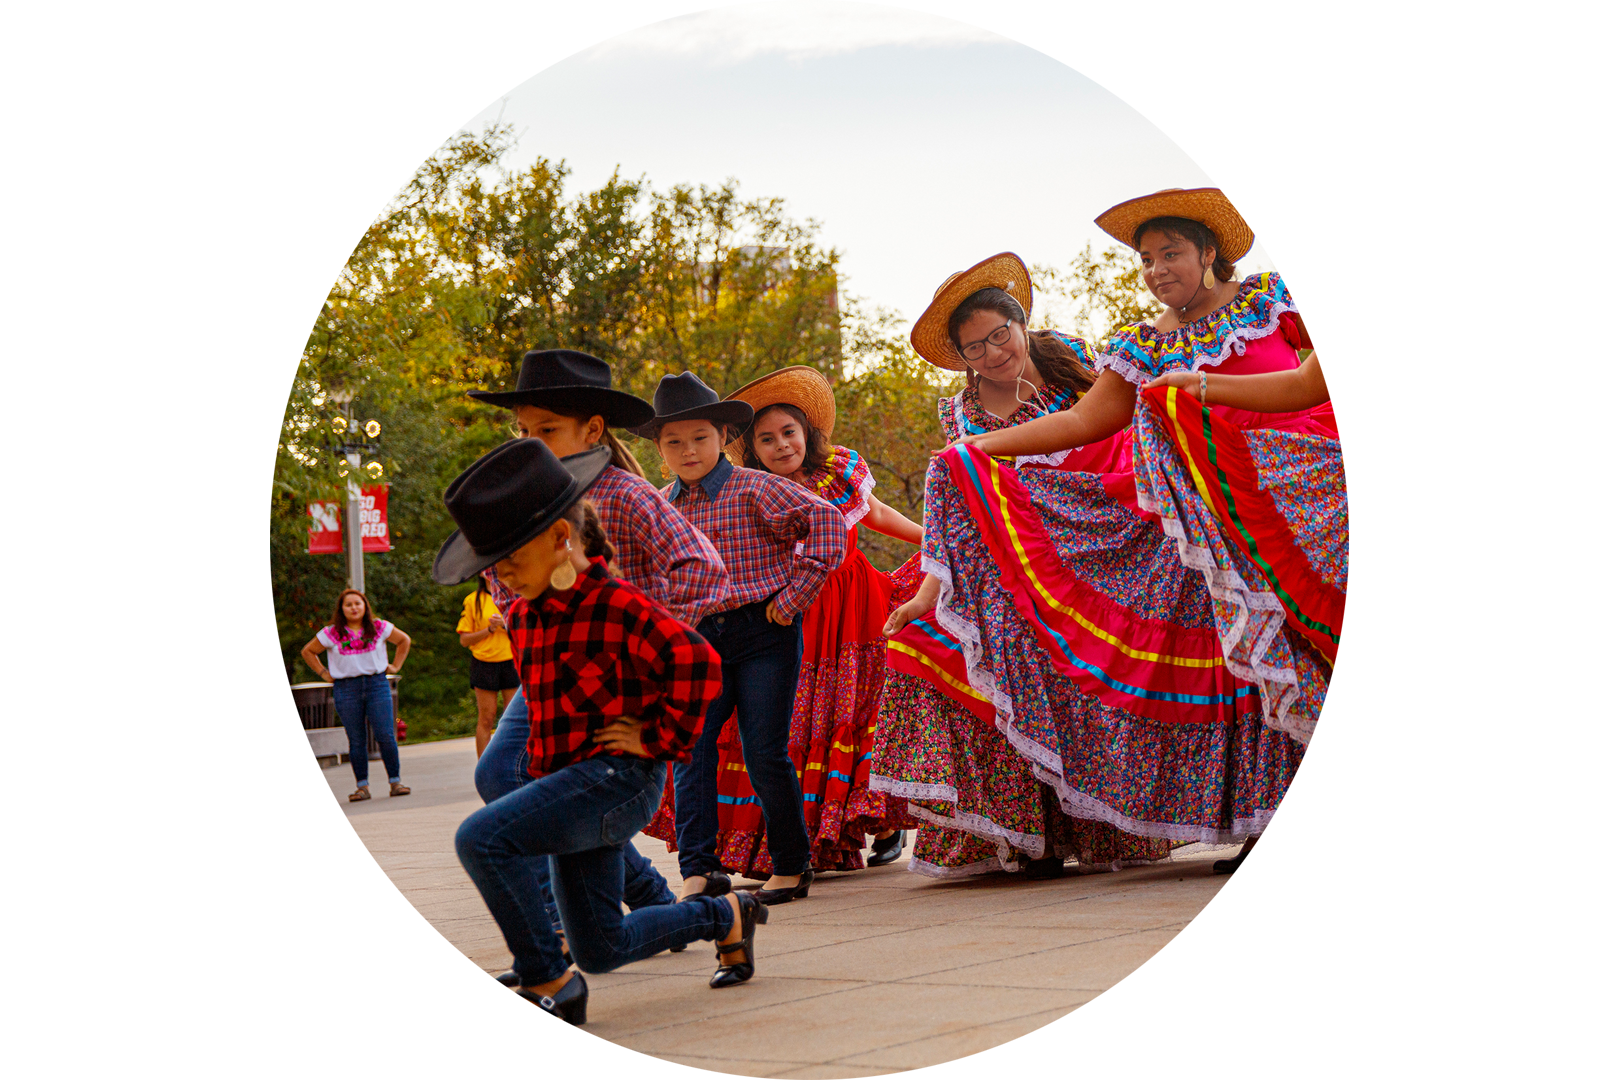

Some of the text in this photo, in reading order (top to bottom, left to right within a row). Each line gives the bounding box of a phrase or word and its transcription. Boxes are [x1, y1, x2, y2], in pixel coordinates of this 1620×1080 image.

[310, 503, 339, 532] N
[360, 509, 381, 523] BIG
[361, 523, 386, 537] RED
